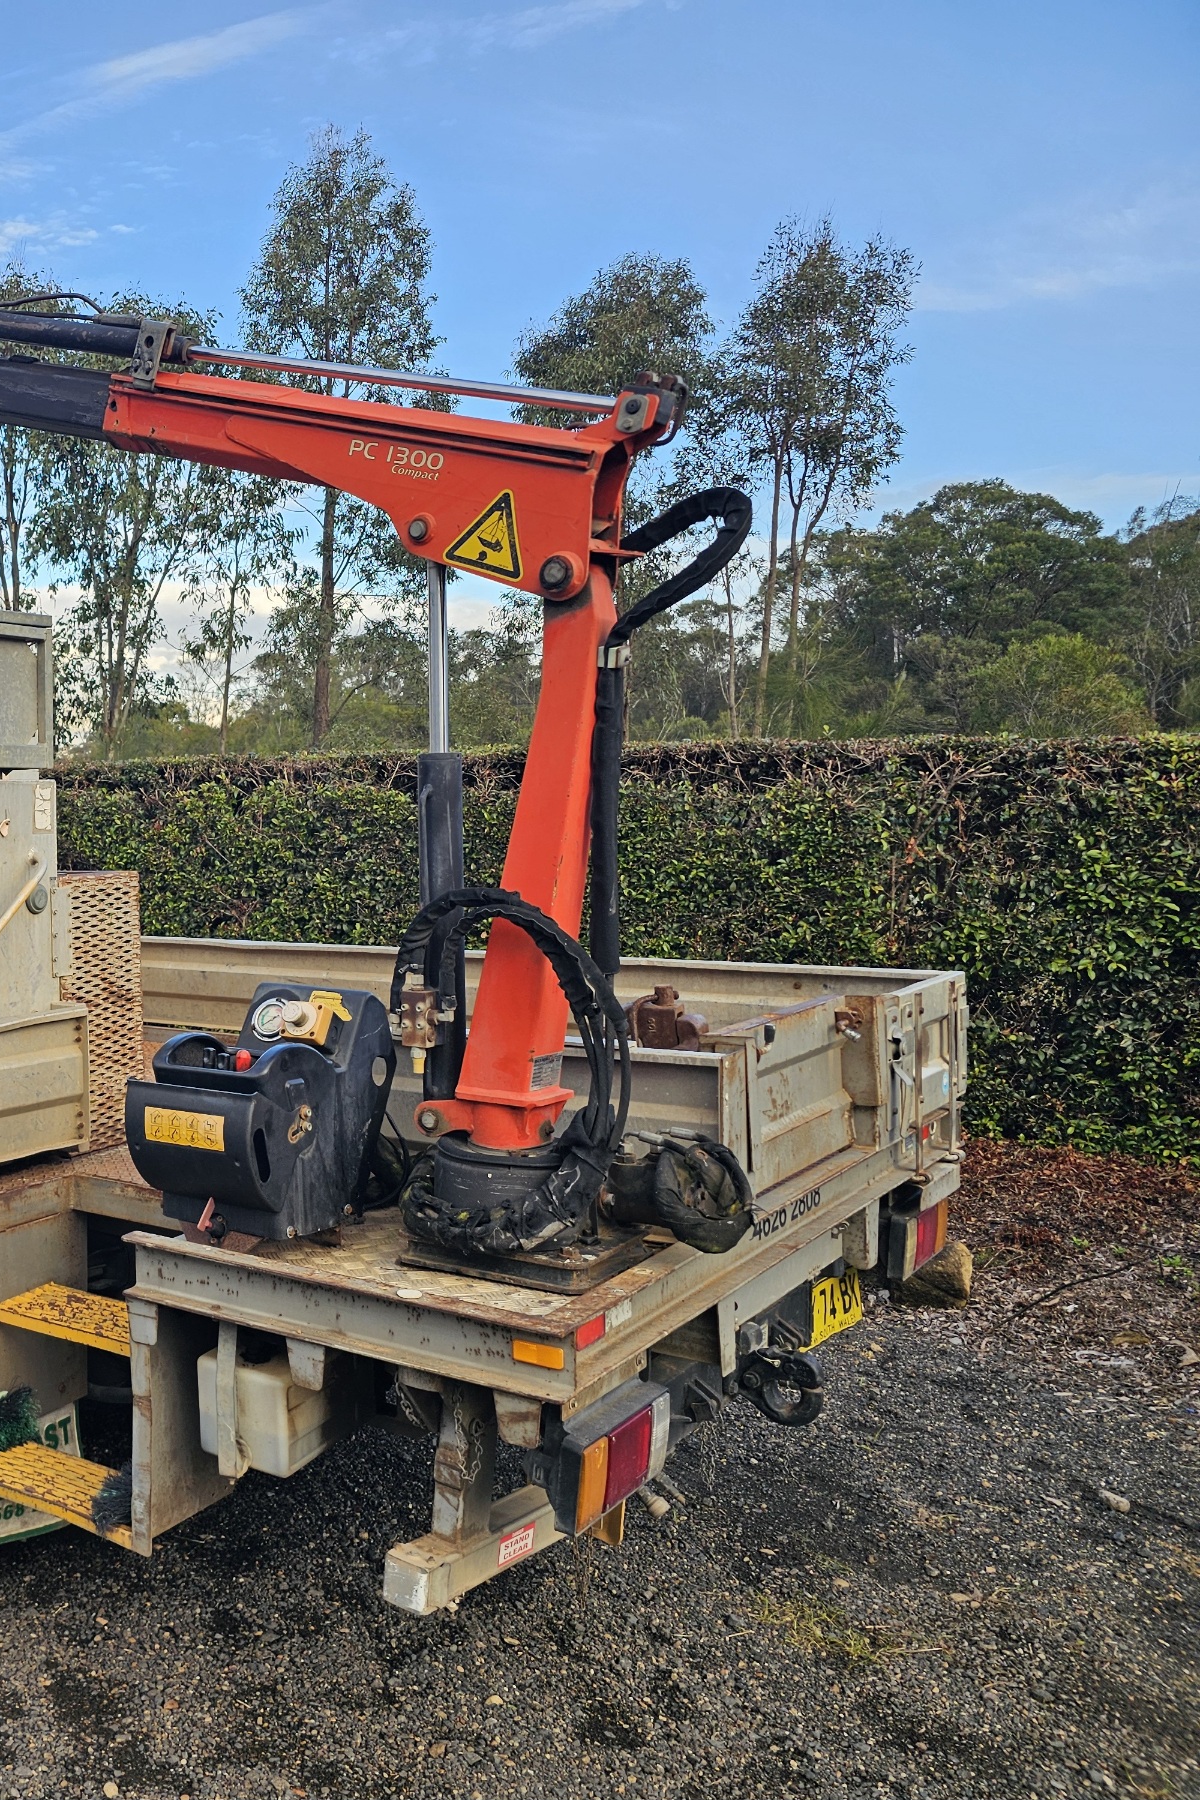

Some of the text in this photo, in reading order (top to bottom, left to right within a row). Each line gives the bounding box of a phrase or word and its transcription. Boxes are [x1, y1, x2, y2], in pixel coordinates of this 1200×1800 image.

[348, 439, 444, 470] PC 1300
[391, 464, 439, 480] Compact
[752, 1187, 821, 1241] 4626 2808
[503, 1533, 530, 1551] STAND
[503, 1542, 529, 1560] CLEAR
